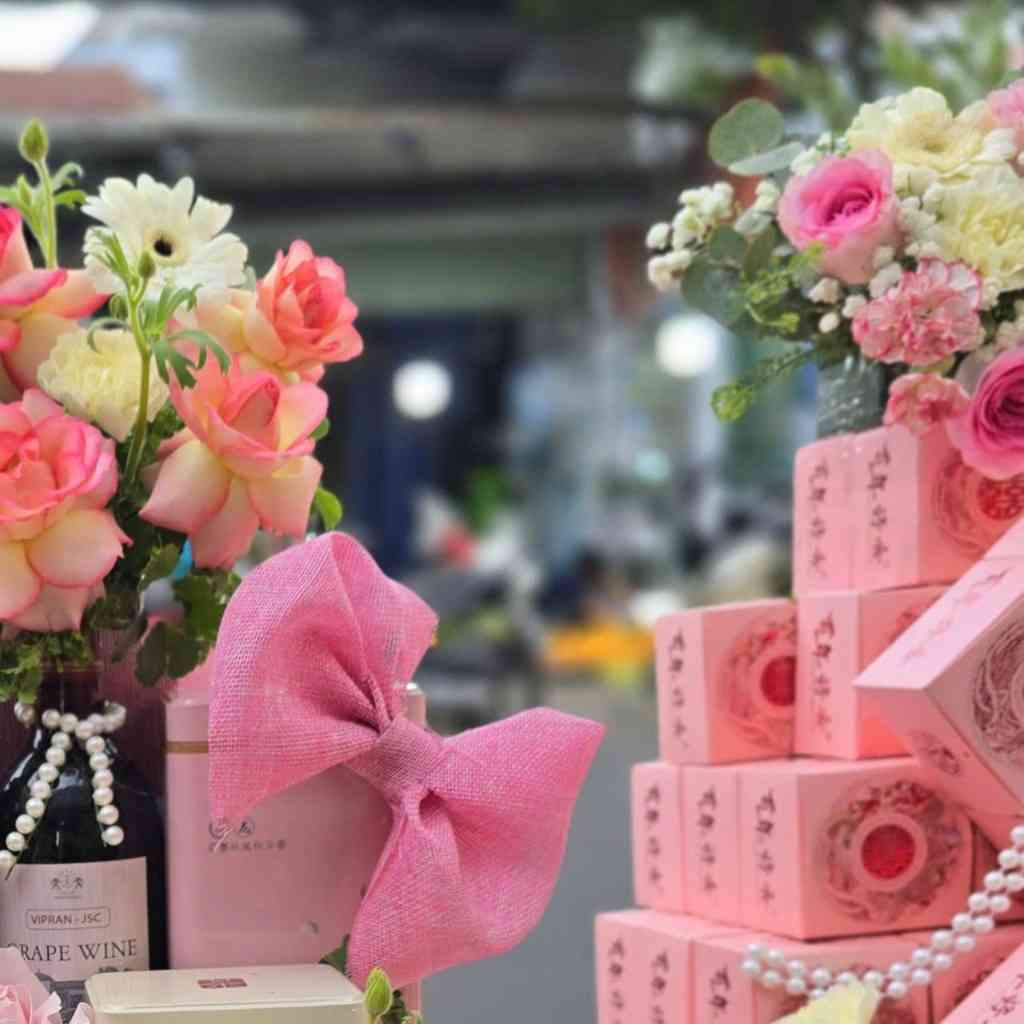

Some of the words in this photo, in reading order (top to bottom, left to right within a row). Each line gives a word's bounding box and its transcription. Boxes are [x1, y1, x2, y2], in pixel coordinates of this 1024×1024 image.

[30, 913, 73, 925] VIPRAN
[81, 912, 102, 924] JSC
[7, 943, 72, 962] RAPE
[78, 938, 137, 961] WINE
